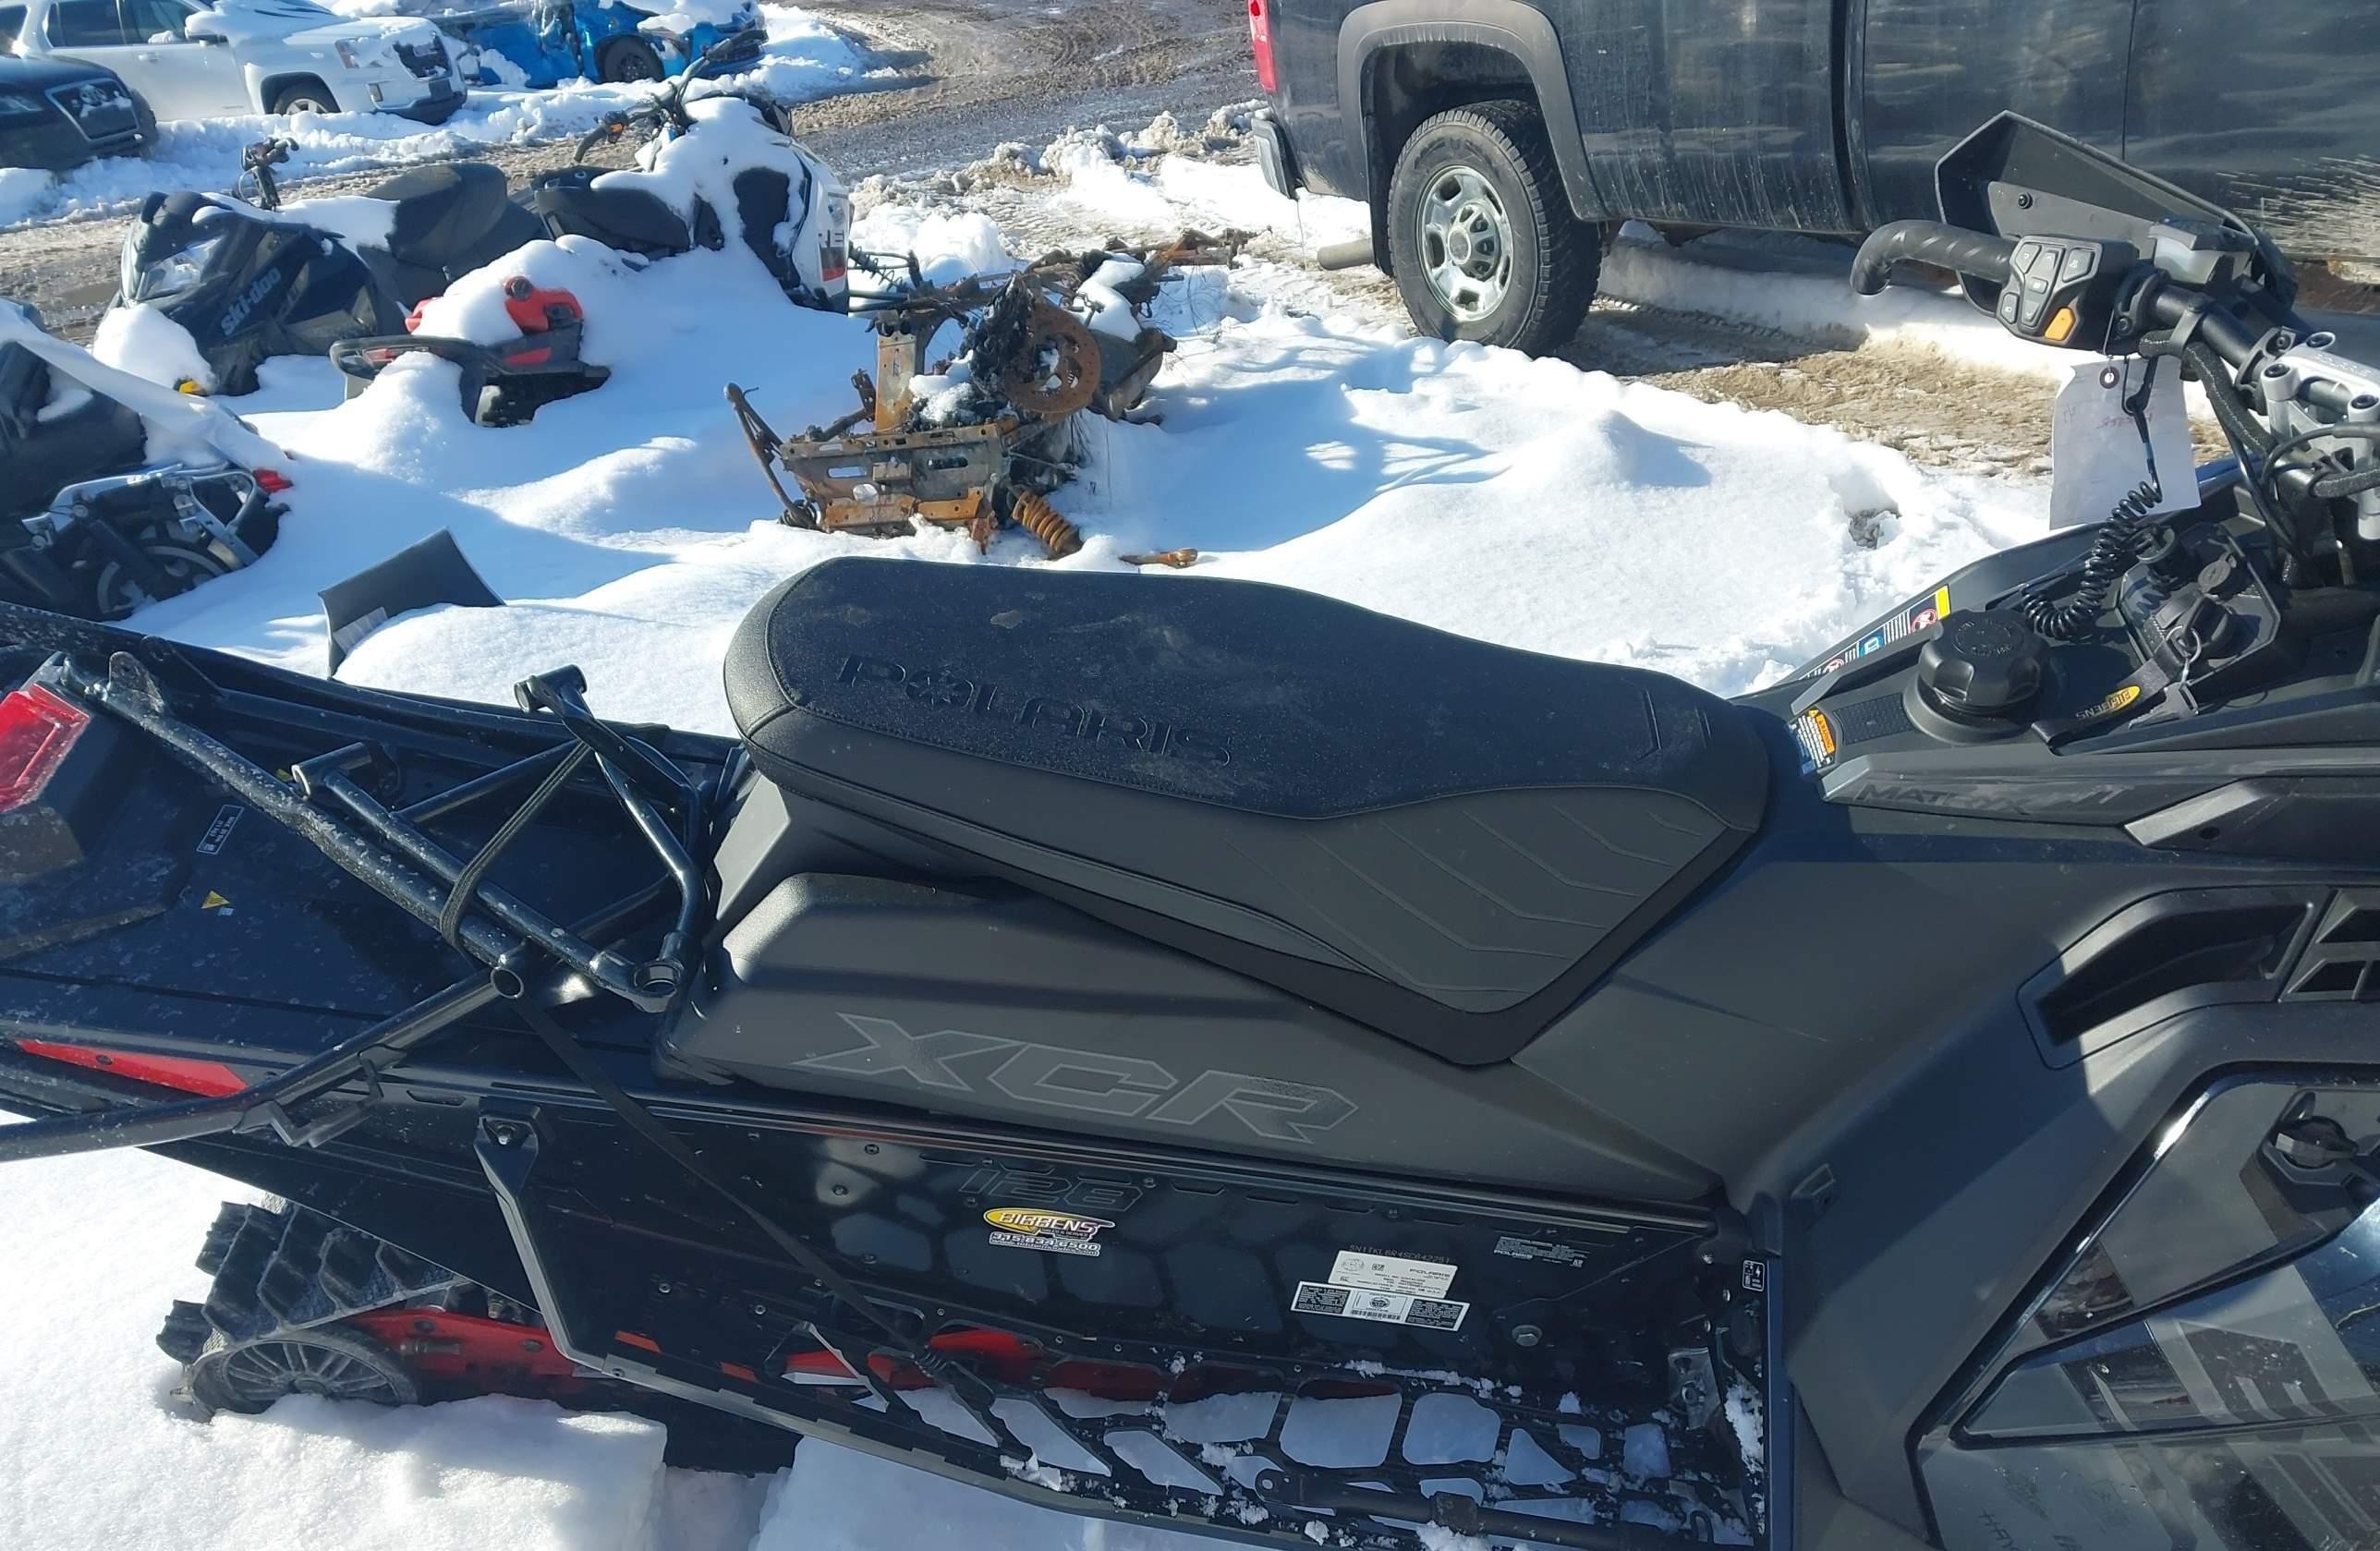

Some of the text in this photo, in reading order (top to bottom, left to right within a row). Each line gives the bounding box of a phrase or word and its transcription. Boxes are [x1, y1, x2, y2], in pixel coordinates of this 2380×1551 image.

[222, 267, 281, 334] ski-doo
[837, 654, 1232, 768] POLARIS
[790, 1012, 1361, 1144] XCR
[999, 1212, 1098, 1233] BIBBENS
